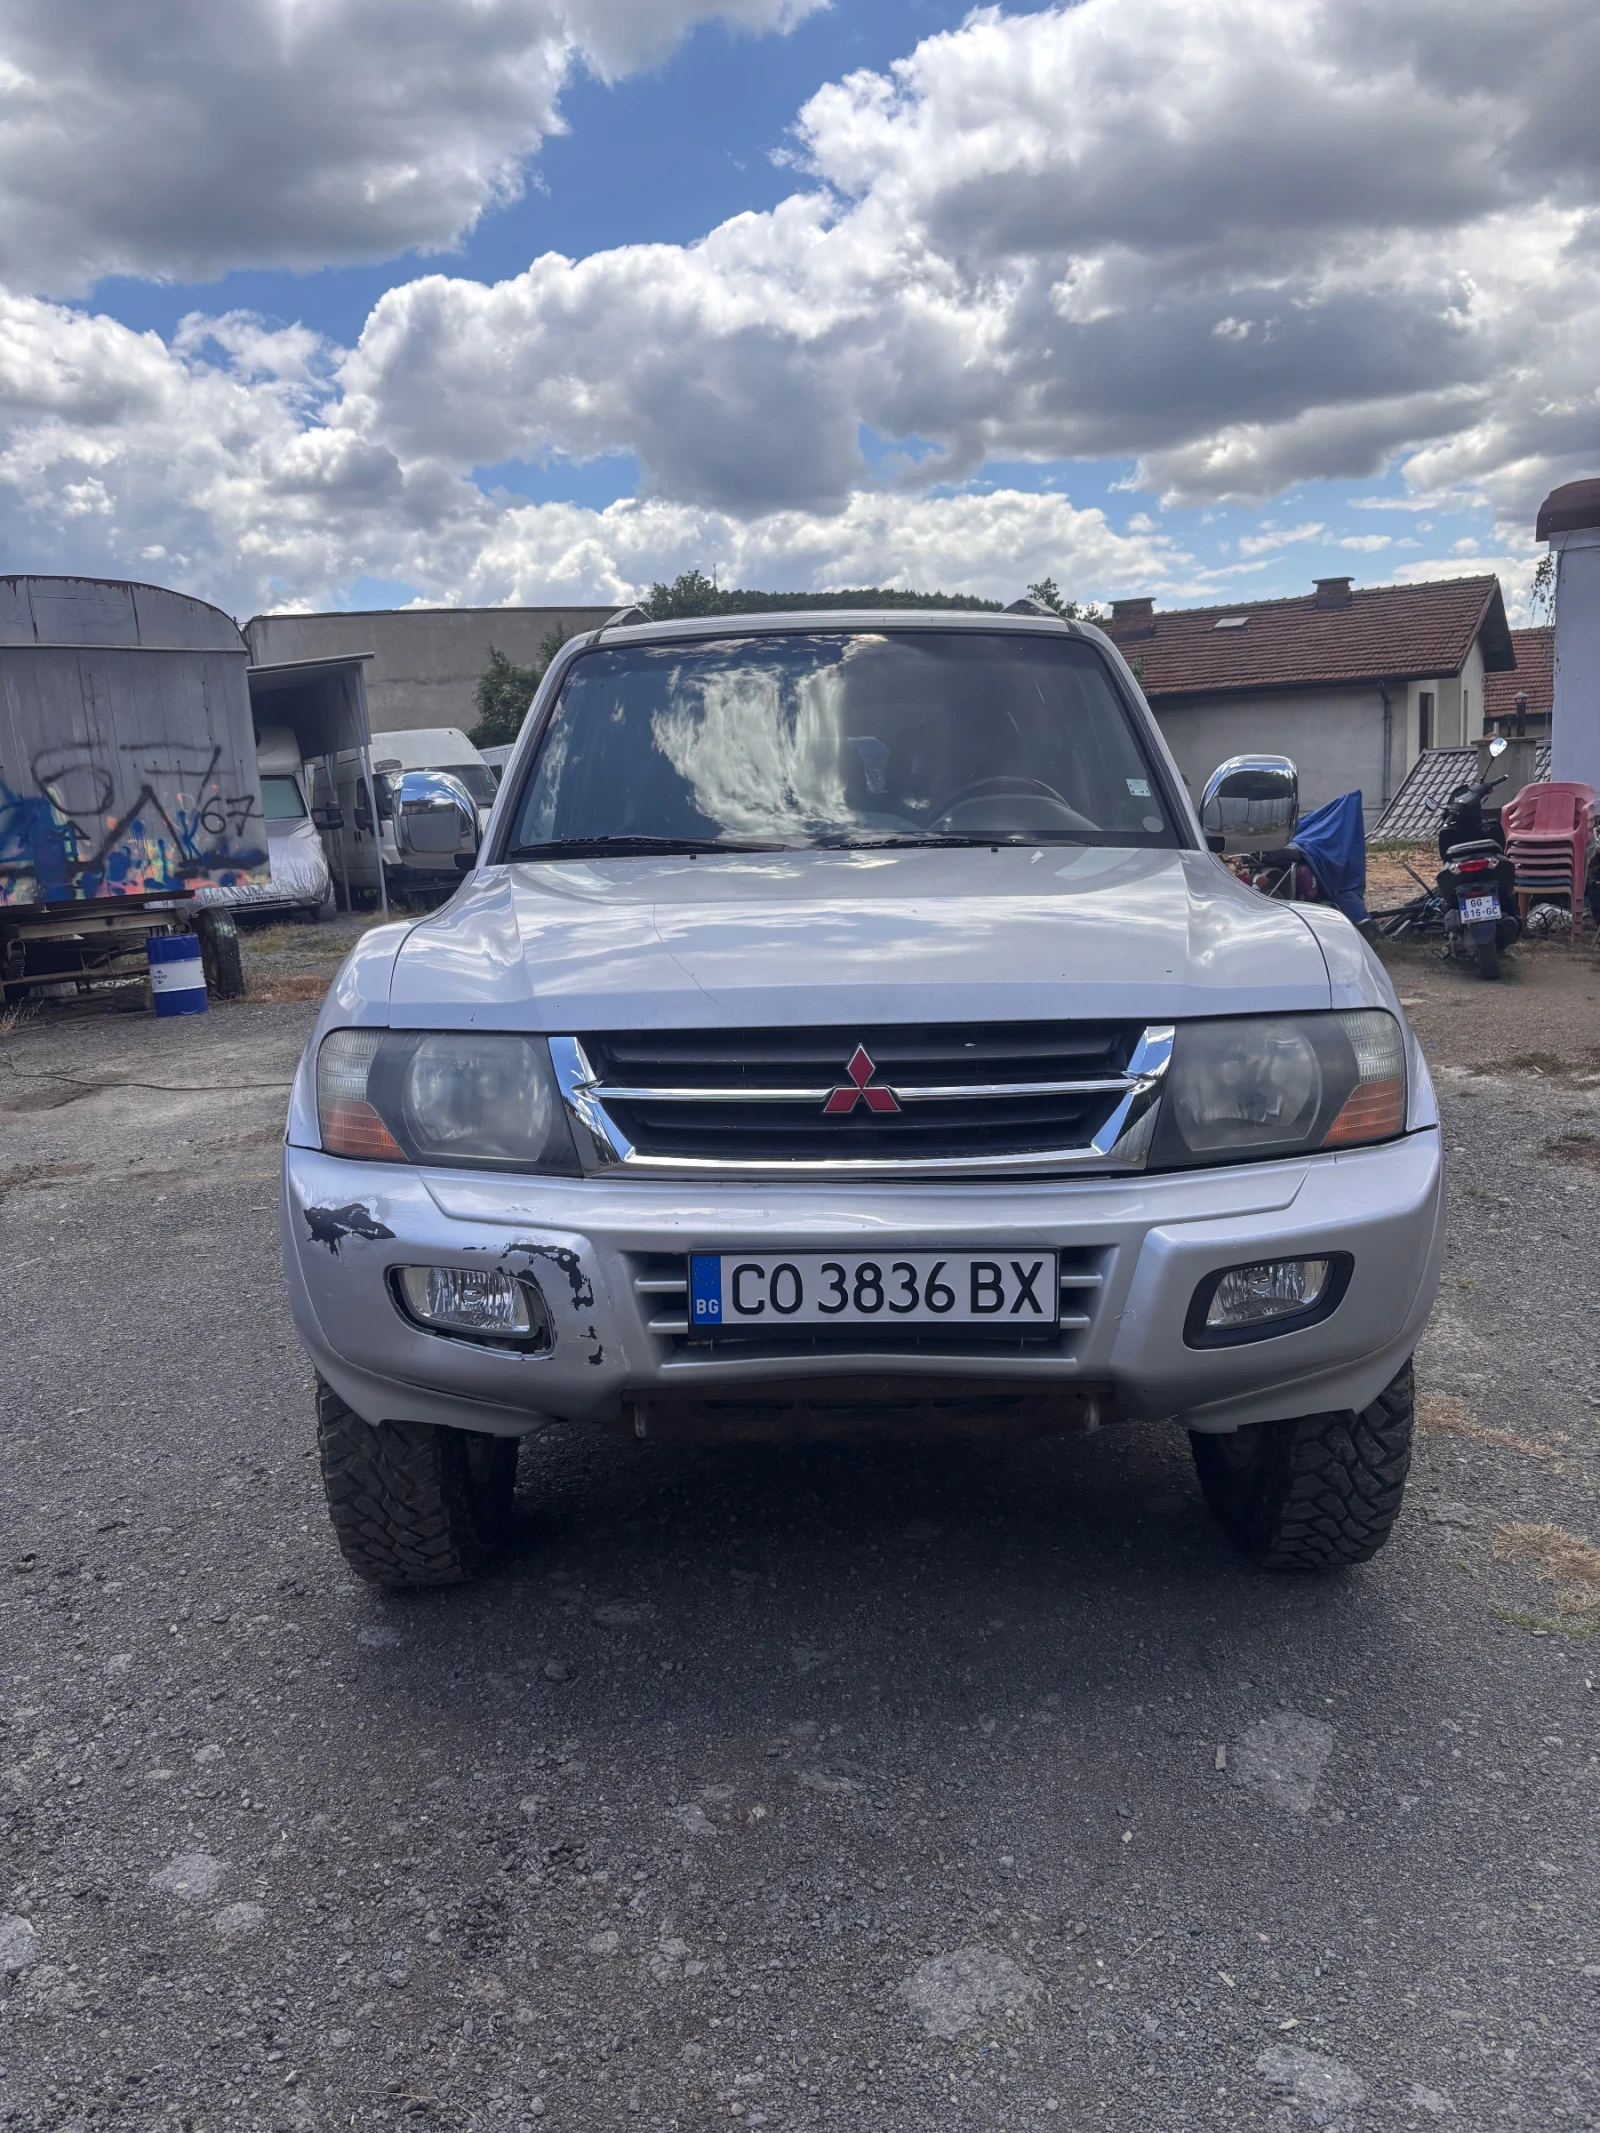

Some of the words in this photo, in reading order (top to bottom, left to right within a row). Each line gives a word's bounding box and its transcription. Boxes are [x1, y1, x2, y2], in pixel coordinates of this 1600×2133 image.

[1471, 899, 1482, 907] GG
[1464, 907, 1498, 918] 615-GC
[731, 1262, 803, 1316] CO
[817, 1261, 956, 1315] 3836
[969, 1261, 1044, 1315] BX
[696, 1298, 719, 1315] BG
